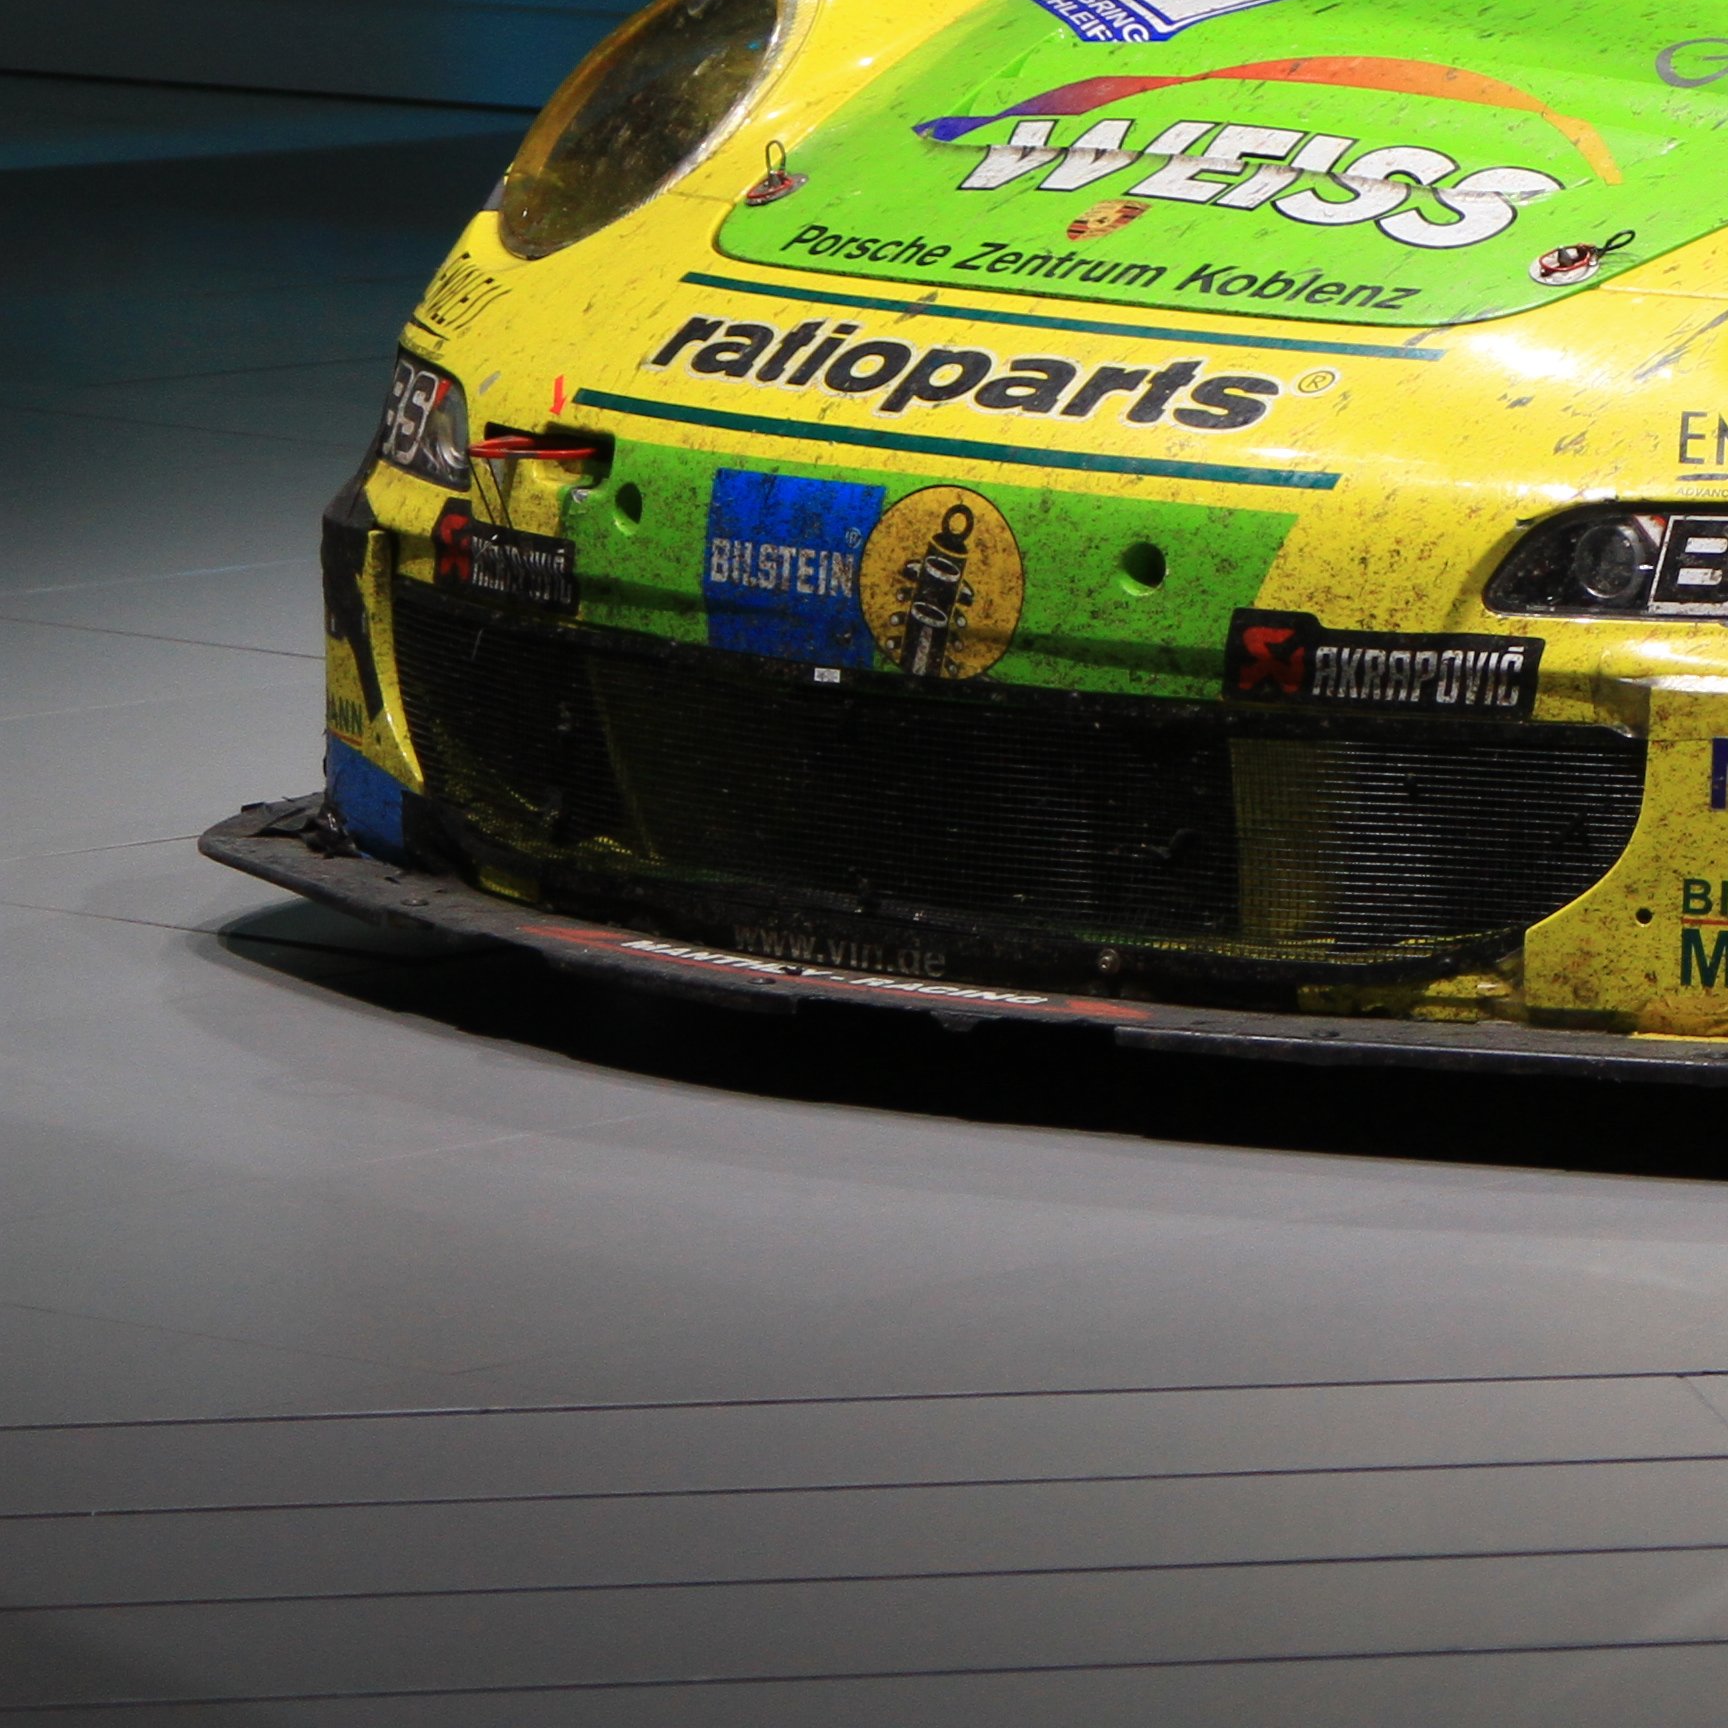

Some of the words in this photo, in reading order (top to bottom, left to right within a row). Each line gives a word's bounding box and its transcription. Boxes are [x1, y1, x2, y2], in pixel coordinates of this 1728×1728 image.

[957, 118, 1566, 252] WEISS
[780, 222, 950, 268] Porsche
[955, 242, 1166, 290] Zentrum
[1175, 260, 1422, 311] Koblenz
[646, 312, 1281, 432] ratioparts
[708, 536, 855, 599] BILSTEIN
[849, 976, 1049, 1006] RACING
